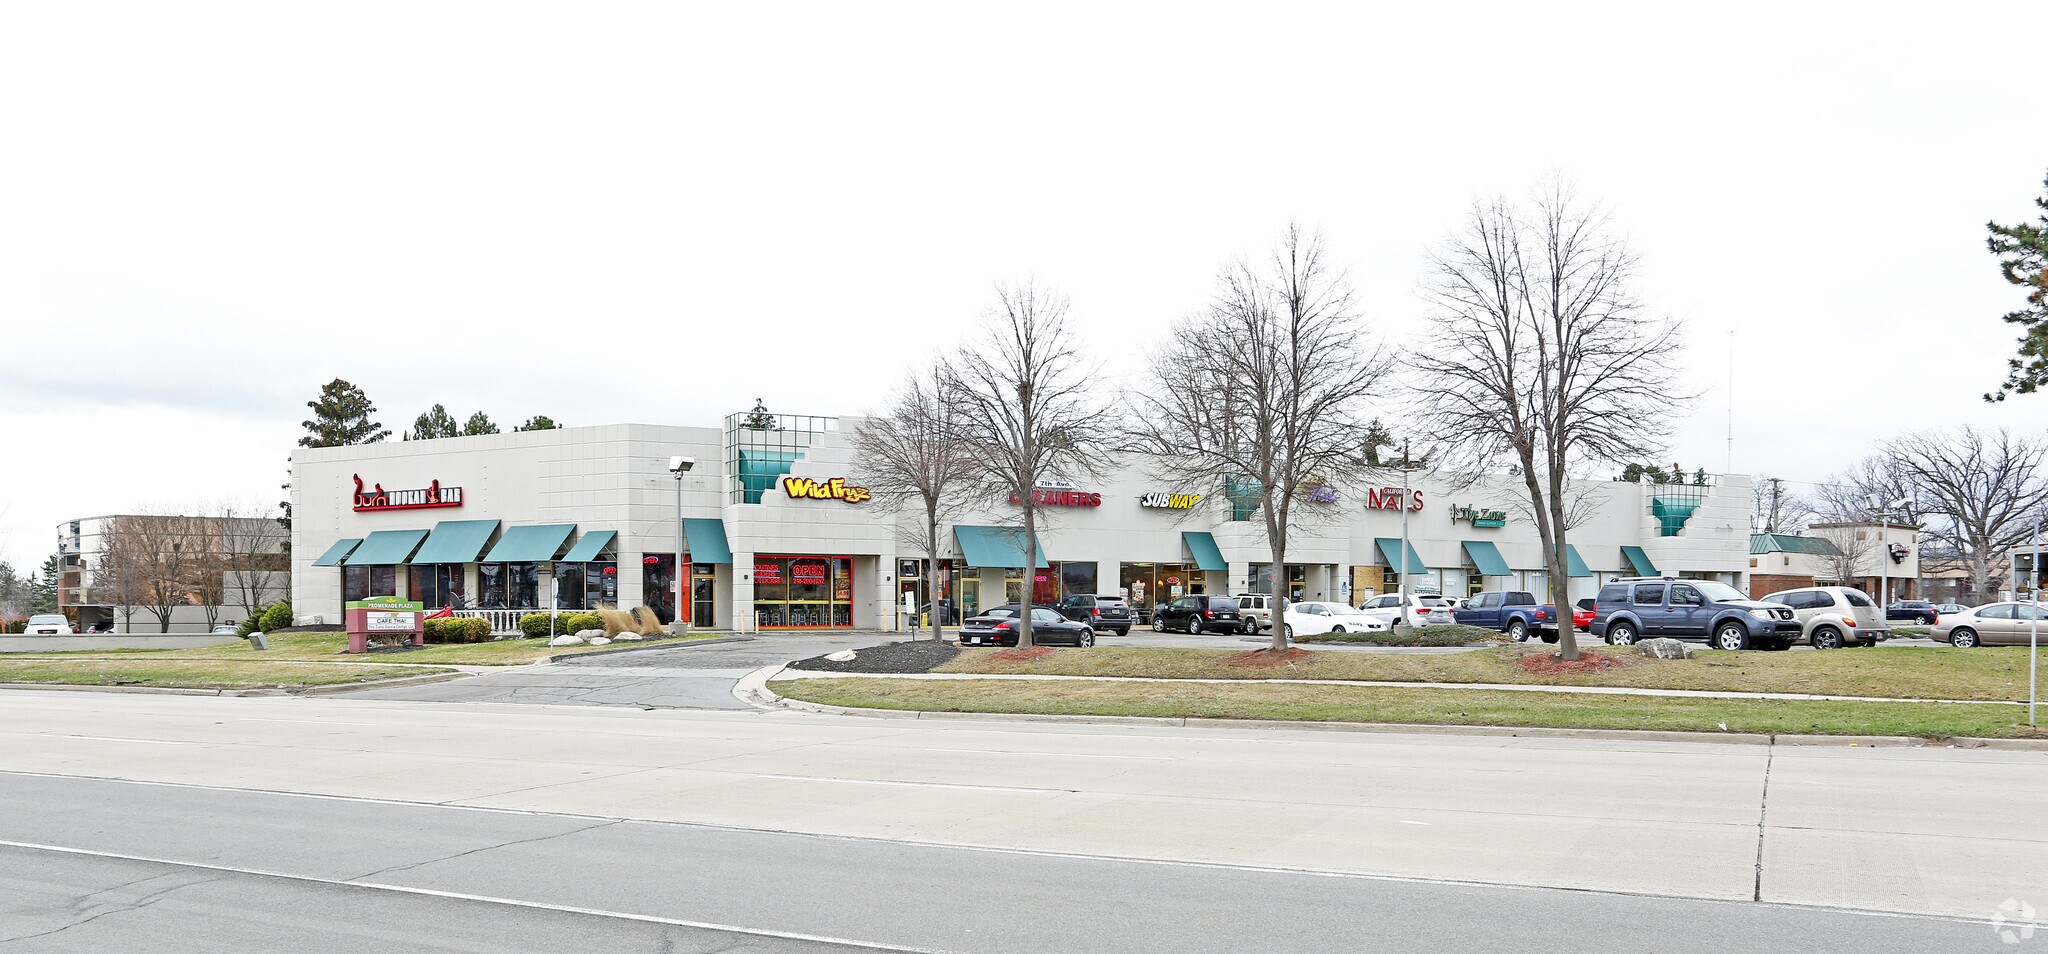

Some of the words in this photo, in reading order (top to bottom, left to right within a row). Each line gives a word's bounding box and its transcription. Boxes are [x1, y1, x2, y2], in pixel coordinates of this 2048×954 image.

[783, 478, 831, 499] Wild
[1009, 489, 1101, 507] CEANERS
[1141, 492, 1200, 508] SUBWAY
[1367, 487, 1424, 511] NAIS
[792, 564, 825, 576] OPEN
